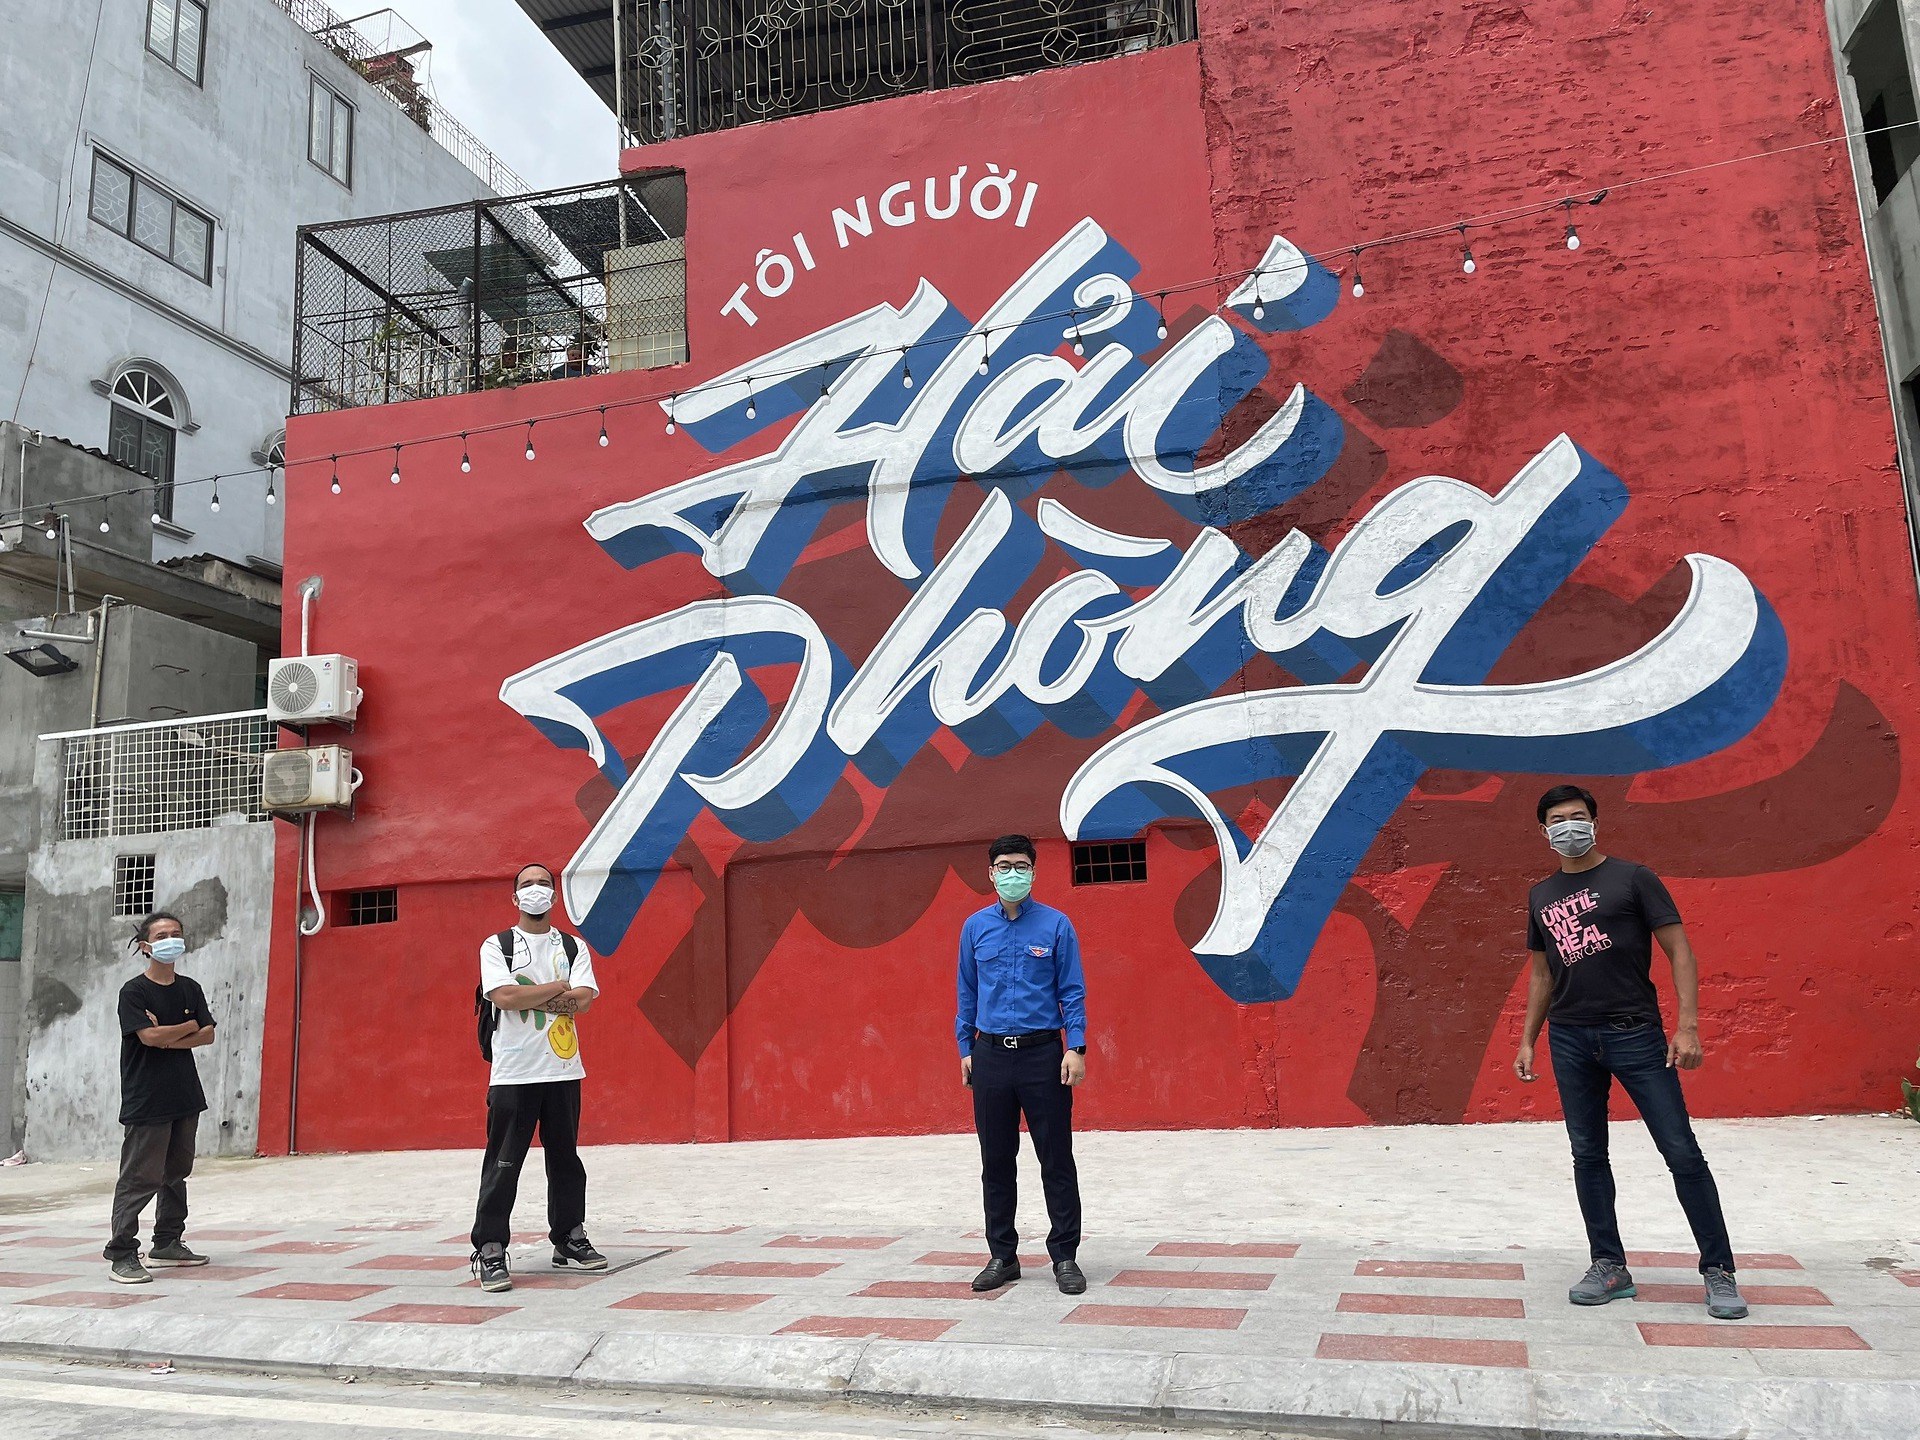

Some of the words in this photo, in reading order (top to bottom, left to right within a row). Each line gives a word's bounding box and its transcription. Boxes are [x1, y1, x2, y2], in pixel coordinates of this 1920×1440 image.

[719, 249, 816, 327] TÔI
[831, 162, 1039, 249] NGƯỜI
[583, 216, 1309, 579] Hải
[499, 432, 1759, 957] Phòng
[1541, 893, 1597, 927] UNTIL
[1548, 914, 1583, 941] WE
[1555, 924, 1608, 959] HEAL
[1562, 948, 1585, 967] EVERY
[1584, 938, 1613, 956] CHILD
